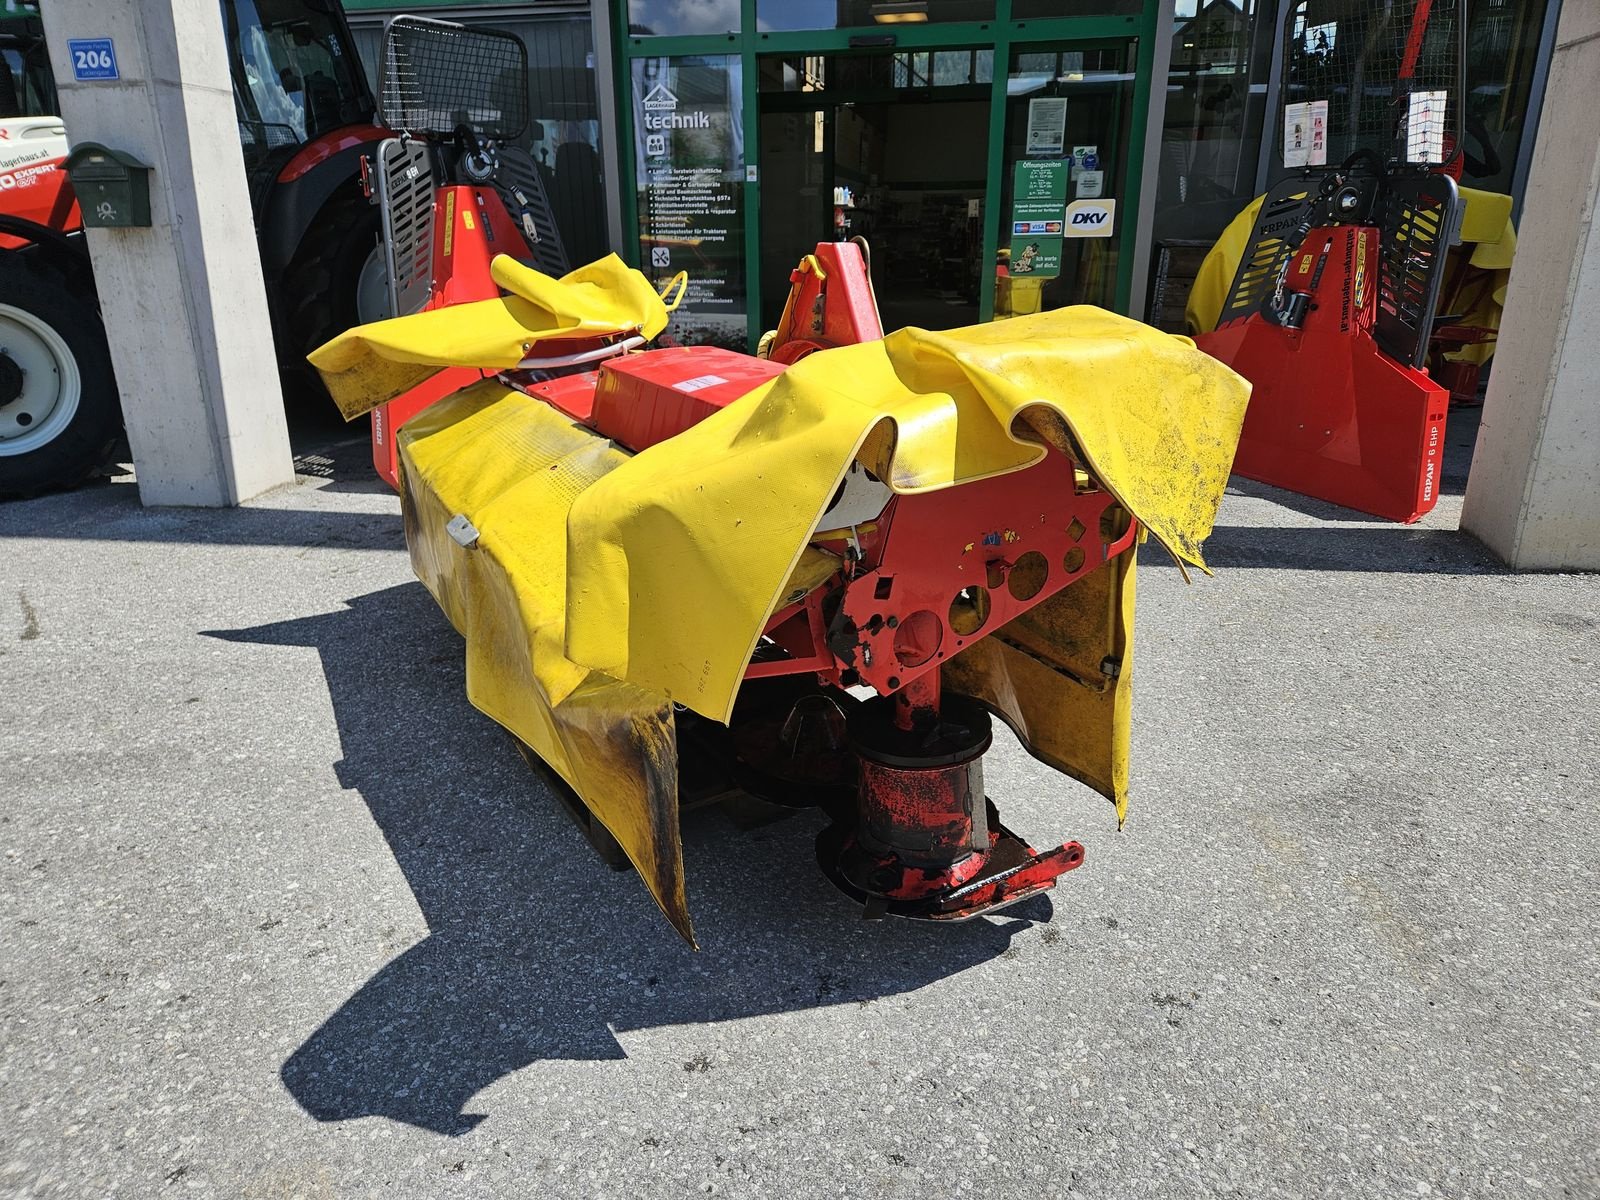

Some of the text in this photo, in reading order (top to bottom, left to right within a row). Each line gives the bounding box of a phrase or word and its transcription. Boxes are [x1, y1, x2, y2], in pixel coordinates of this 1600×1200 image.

[75, 50, 111, 68] 206
[644, 111, 710, 129] technik
[14, 164, 56, 179] EXPERT
[1023, 161, 1062, 169] Öffnungszeiten
[1072, 212, 1108, 224] DKV
[1260, 217, 1299, 236] KRPAN
[1341, 229, 1354, 332] salzburger-lagerhaus.at
[1430, 426, 1438, 446] EHP
